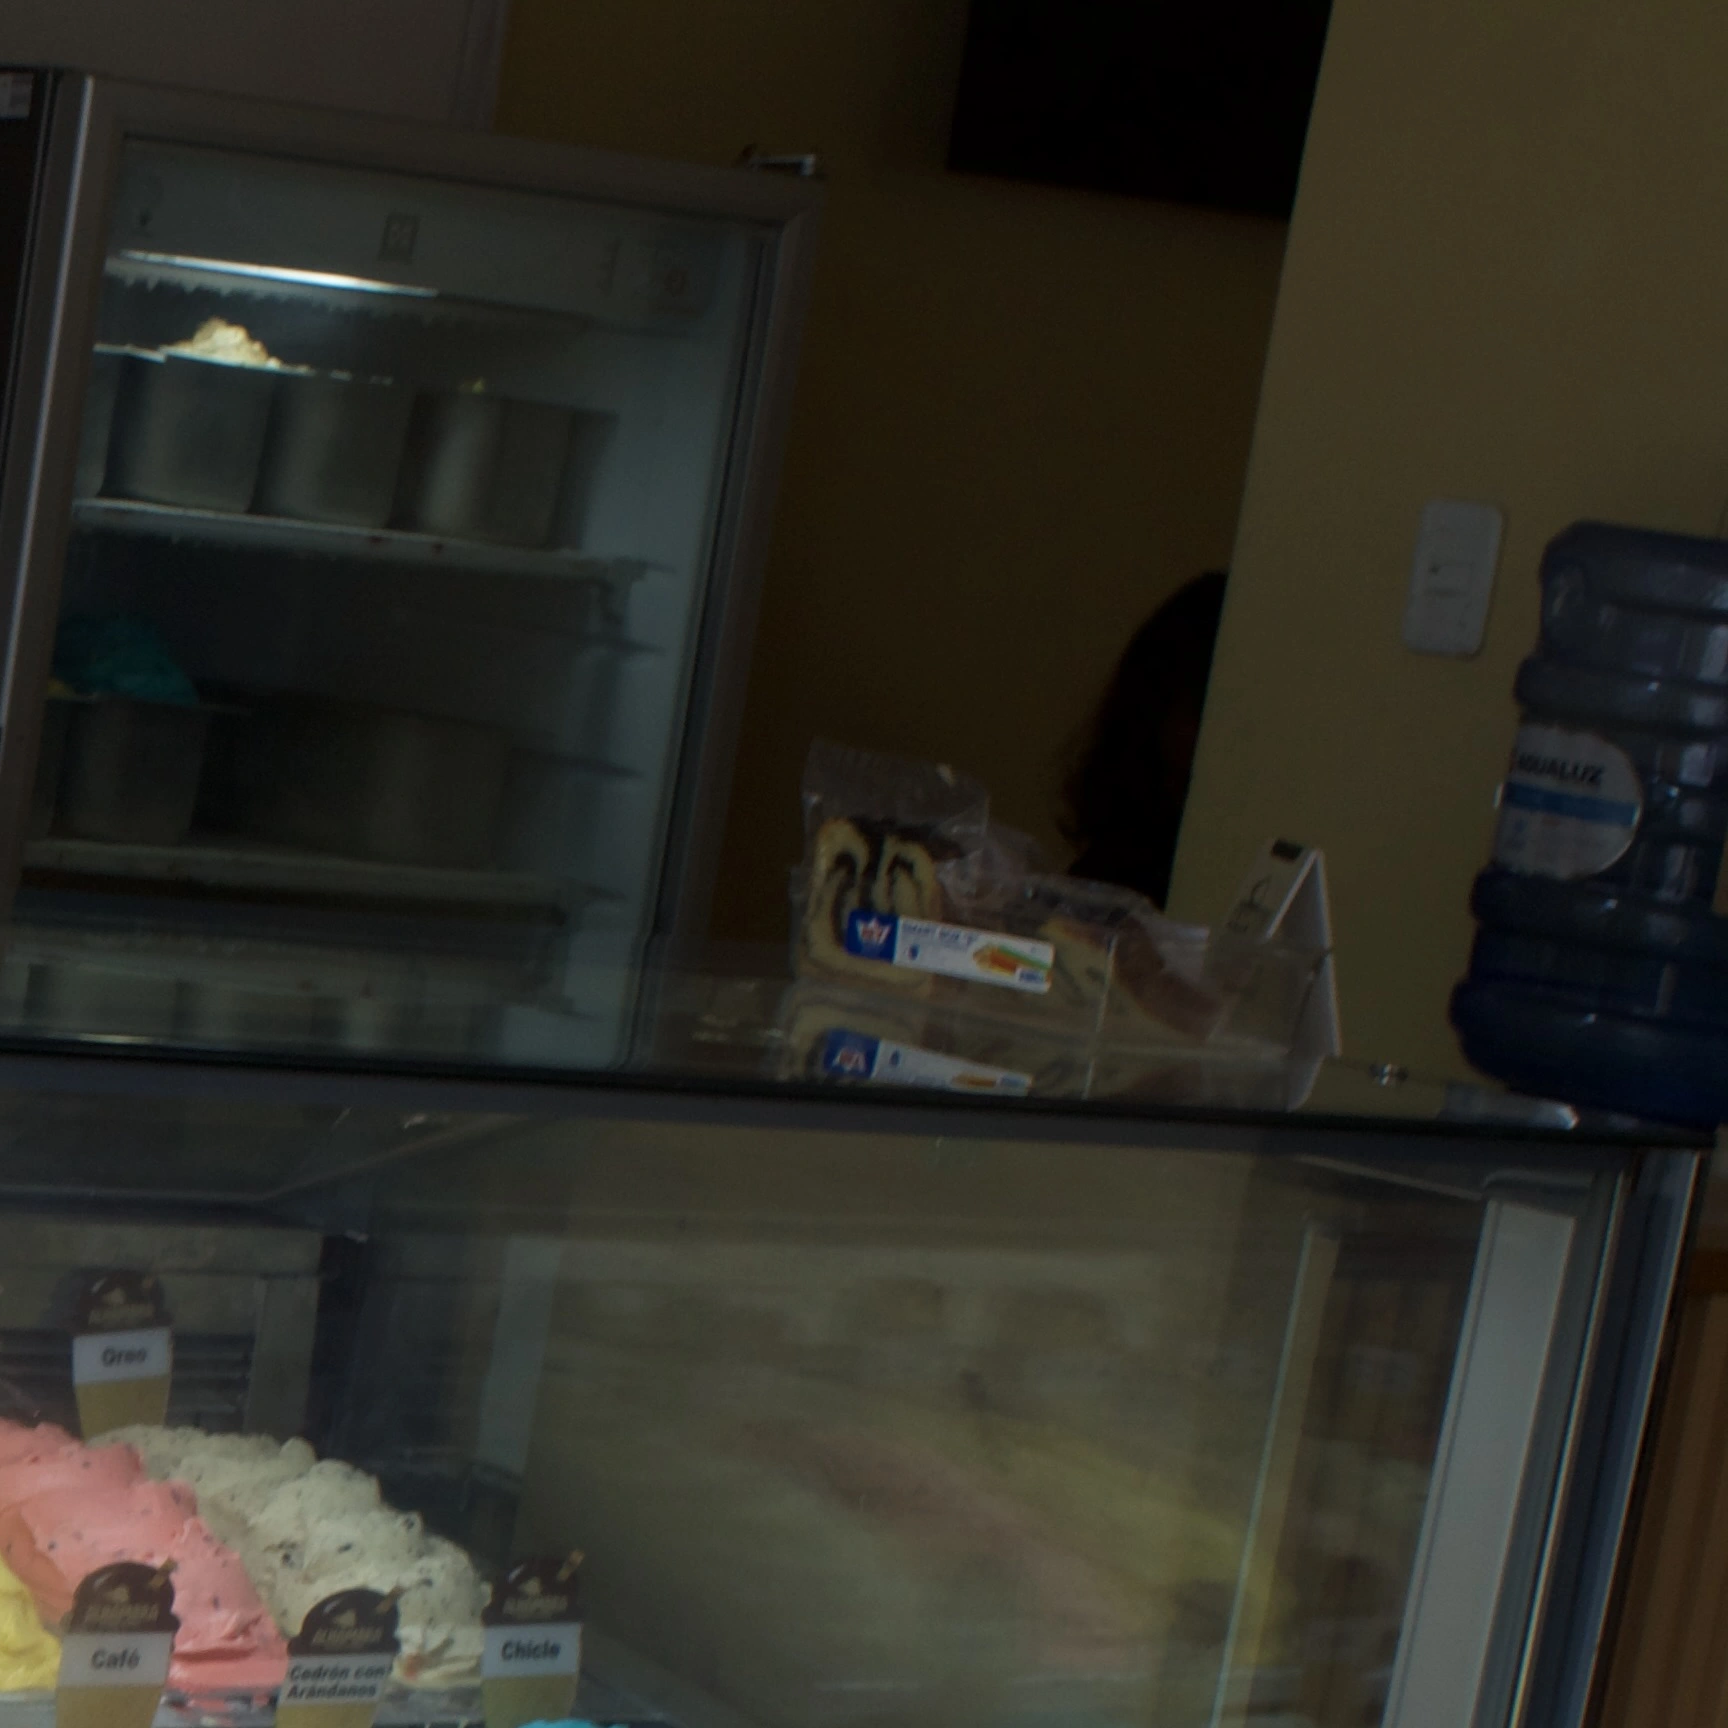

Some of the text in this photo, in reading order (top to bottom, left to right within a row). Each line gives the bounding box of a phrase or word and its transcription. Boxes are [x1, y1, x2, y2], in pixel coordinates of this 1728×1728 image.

[101, 1346, 148, 1368] Oreo
[90, 1646, 141, 1670] Café
[501, 1639, 561, 1662] Chicle
